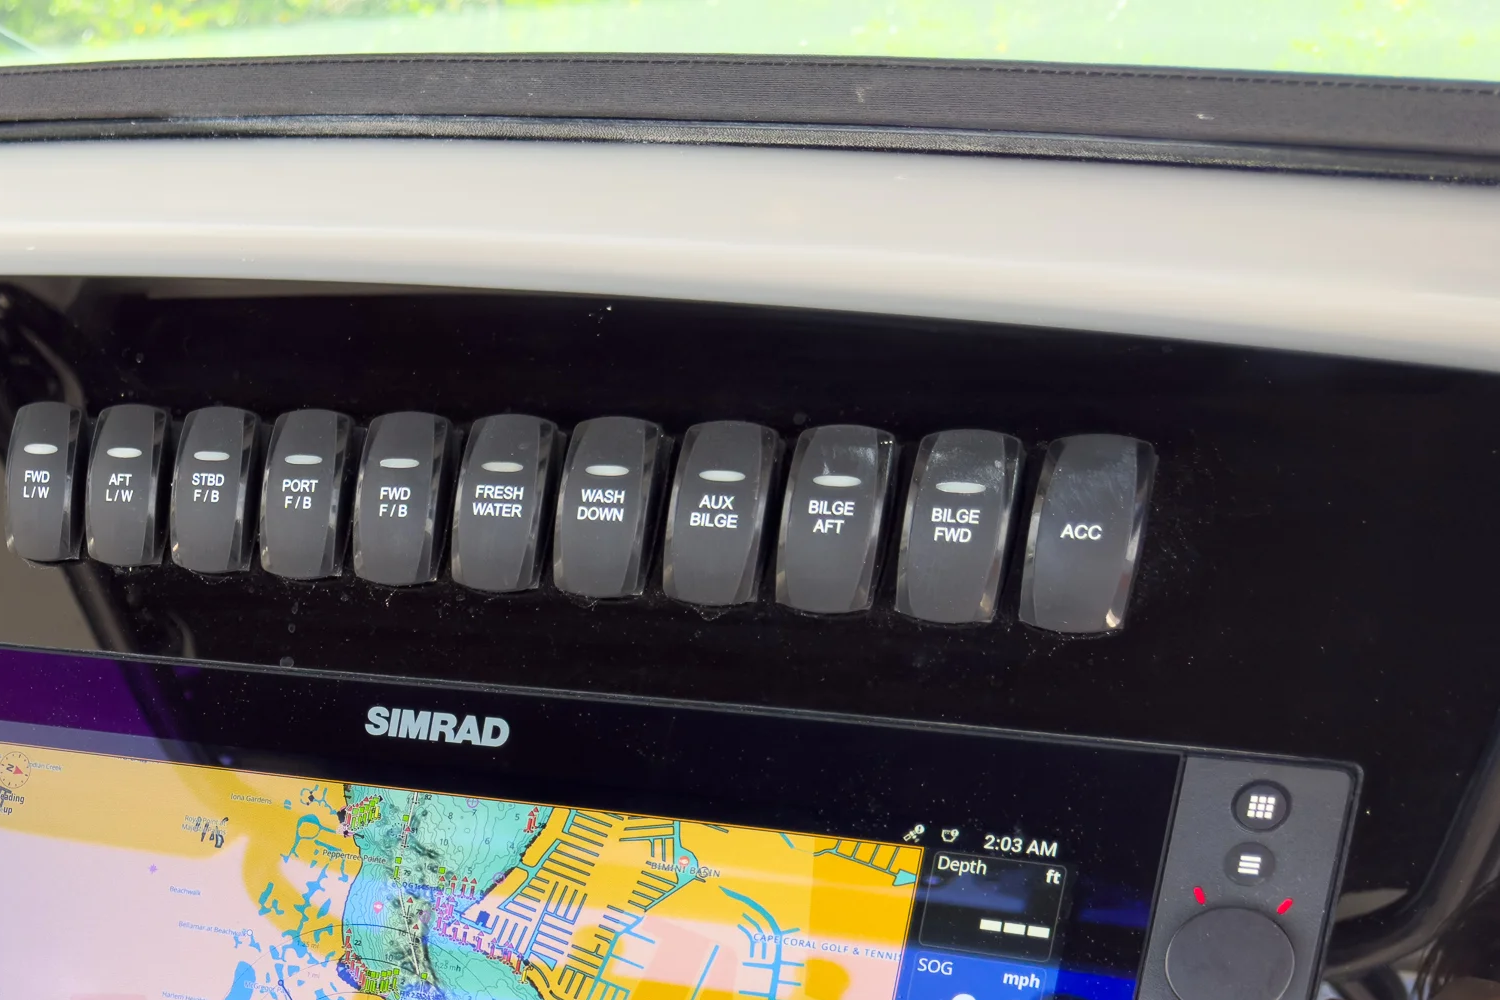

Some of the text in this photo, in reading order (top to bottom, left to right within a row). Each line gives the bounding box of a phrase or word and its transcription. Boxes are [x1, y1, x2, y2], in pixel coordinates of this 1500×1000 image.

[24, 470, 51, 483] FWD
[108, 473, 133, 486] AFT
[191, 473, 225, 487] STBD
[282, 479, 318, 493] PORT
[380, 486, 411, 501] FWD
[475, 484, 525, 501] FRESH
[581, 487, 626, 504] WASH
[699, 494, 735, 510] AUX
[472, 501, 524, 518] WATER
[577, 504, 625, 522] DOWN
[808, 499, 855, 517] BILGE
[931, 506, 980, 525] BILGE
[690, 511, 739, 529] BILGE
[813, 516, 844, 534] AFT
[934, 525, 973, 543] FWD
[1060, 523, 1103, 540] ACC
[365, 706, 509, 747] SIMRAD
[230, 793, 273, 804] Iona Gardens
[3, 806, 13, 815] up
[983, 834, 1058, 857] 2:03 AM
[323, 850, 387, 863] Peppertree Pointe
[651, 862, 721, 878] BIMINI BASIN
[937, 856, 987, 876] Depth
[1046, 869, 1061, 885] ft
[169, 886, 201, 896] Beachwalk
[753, 933, 779, 944] CAPE
[783, 938, 817, 950] CORAL
[821, 943, 849, 954] GOLF
[917, 957, 953, 976] SOG
[1003, 970, 1041, 990] mph
